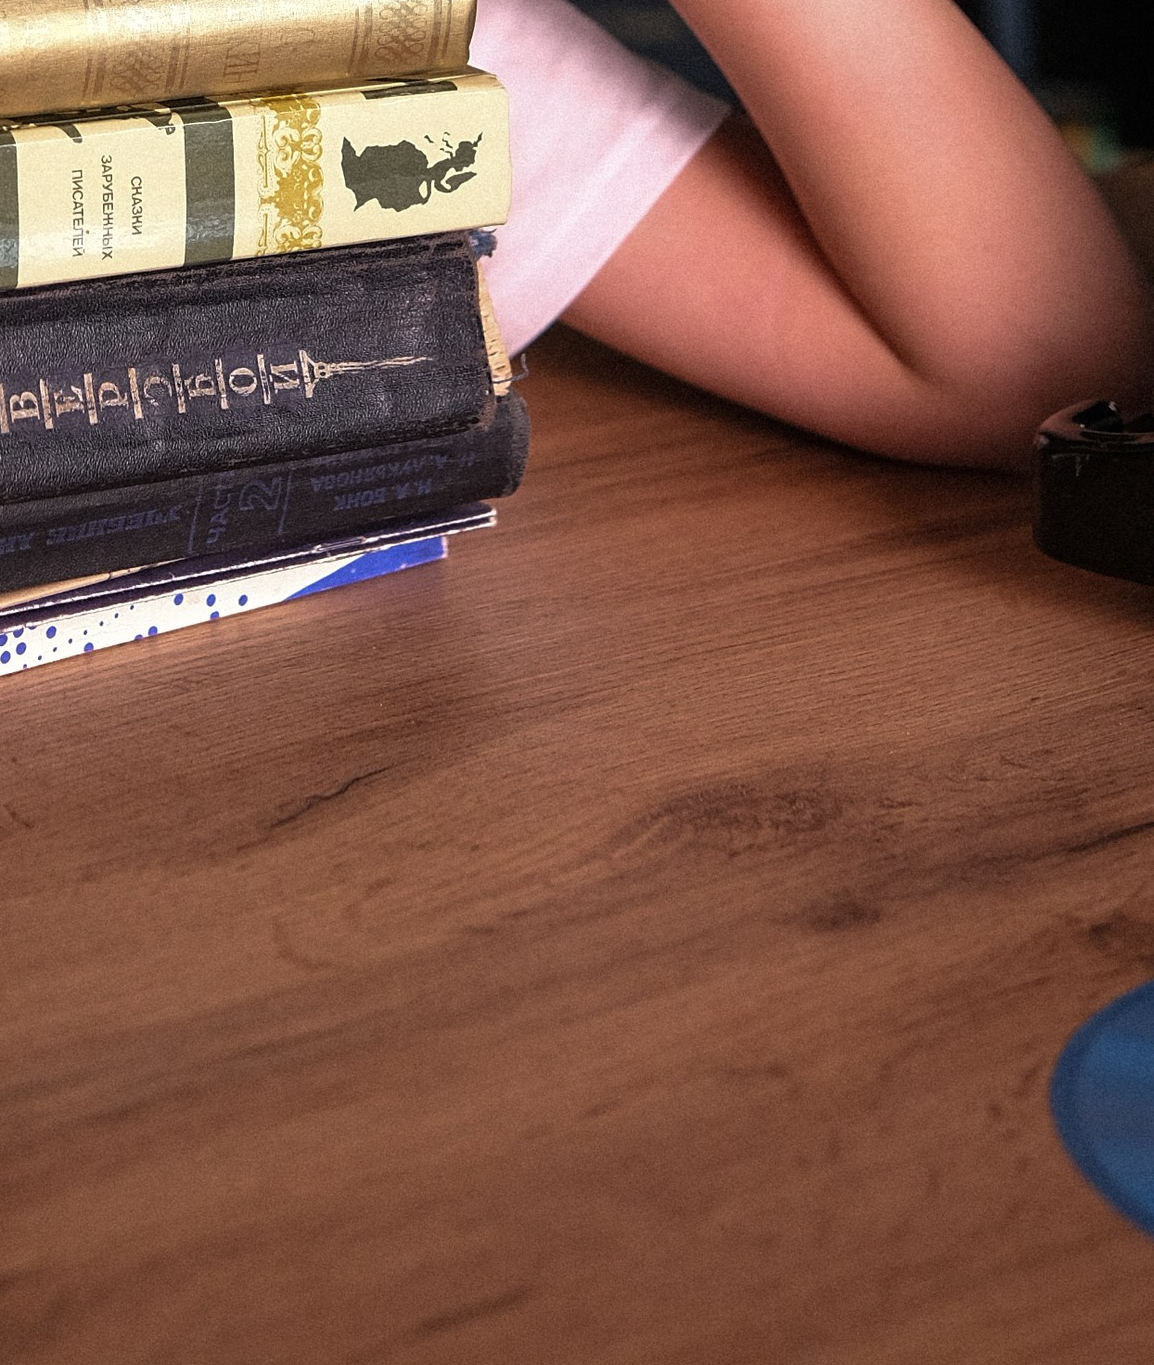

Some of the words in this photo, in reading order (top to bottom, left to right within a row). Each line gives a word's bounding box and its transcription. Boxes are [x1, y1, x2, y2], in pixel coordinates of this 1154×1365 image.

[71, 170, 86, 257] ПИСАТЕЛЕЙ
[101, 155, 114, 260] ЗАРУБЕЖНЫХ
[130, 176, 143, 235] СКАЗКИ
[332, 486, 387, 512] БОНК
